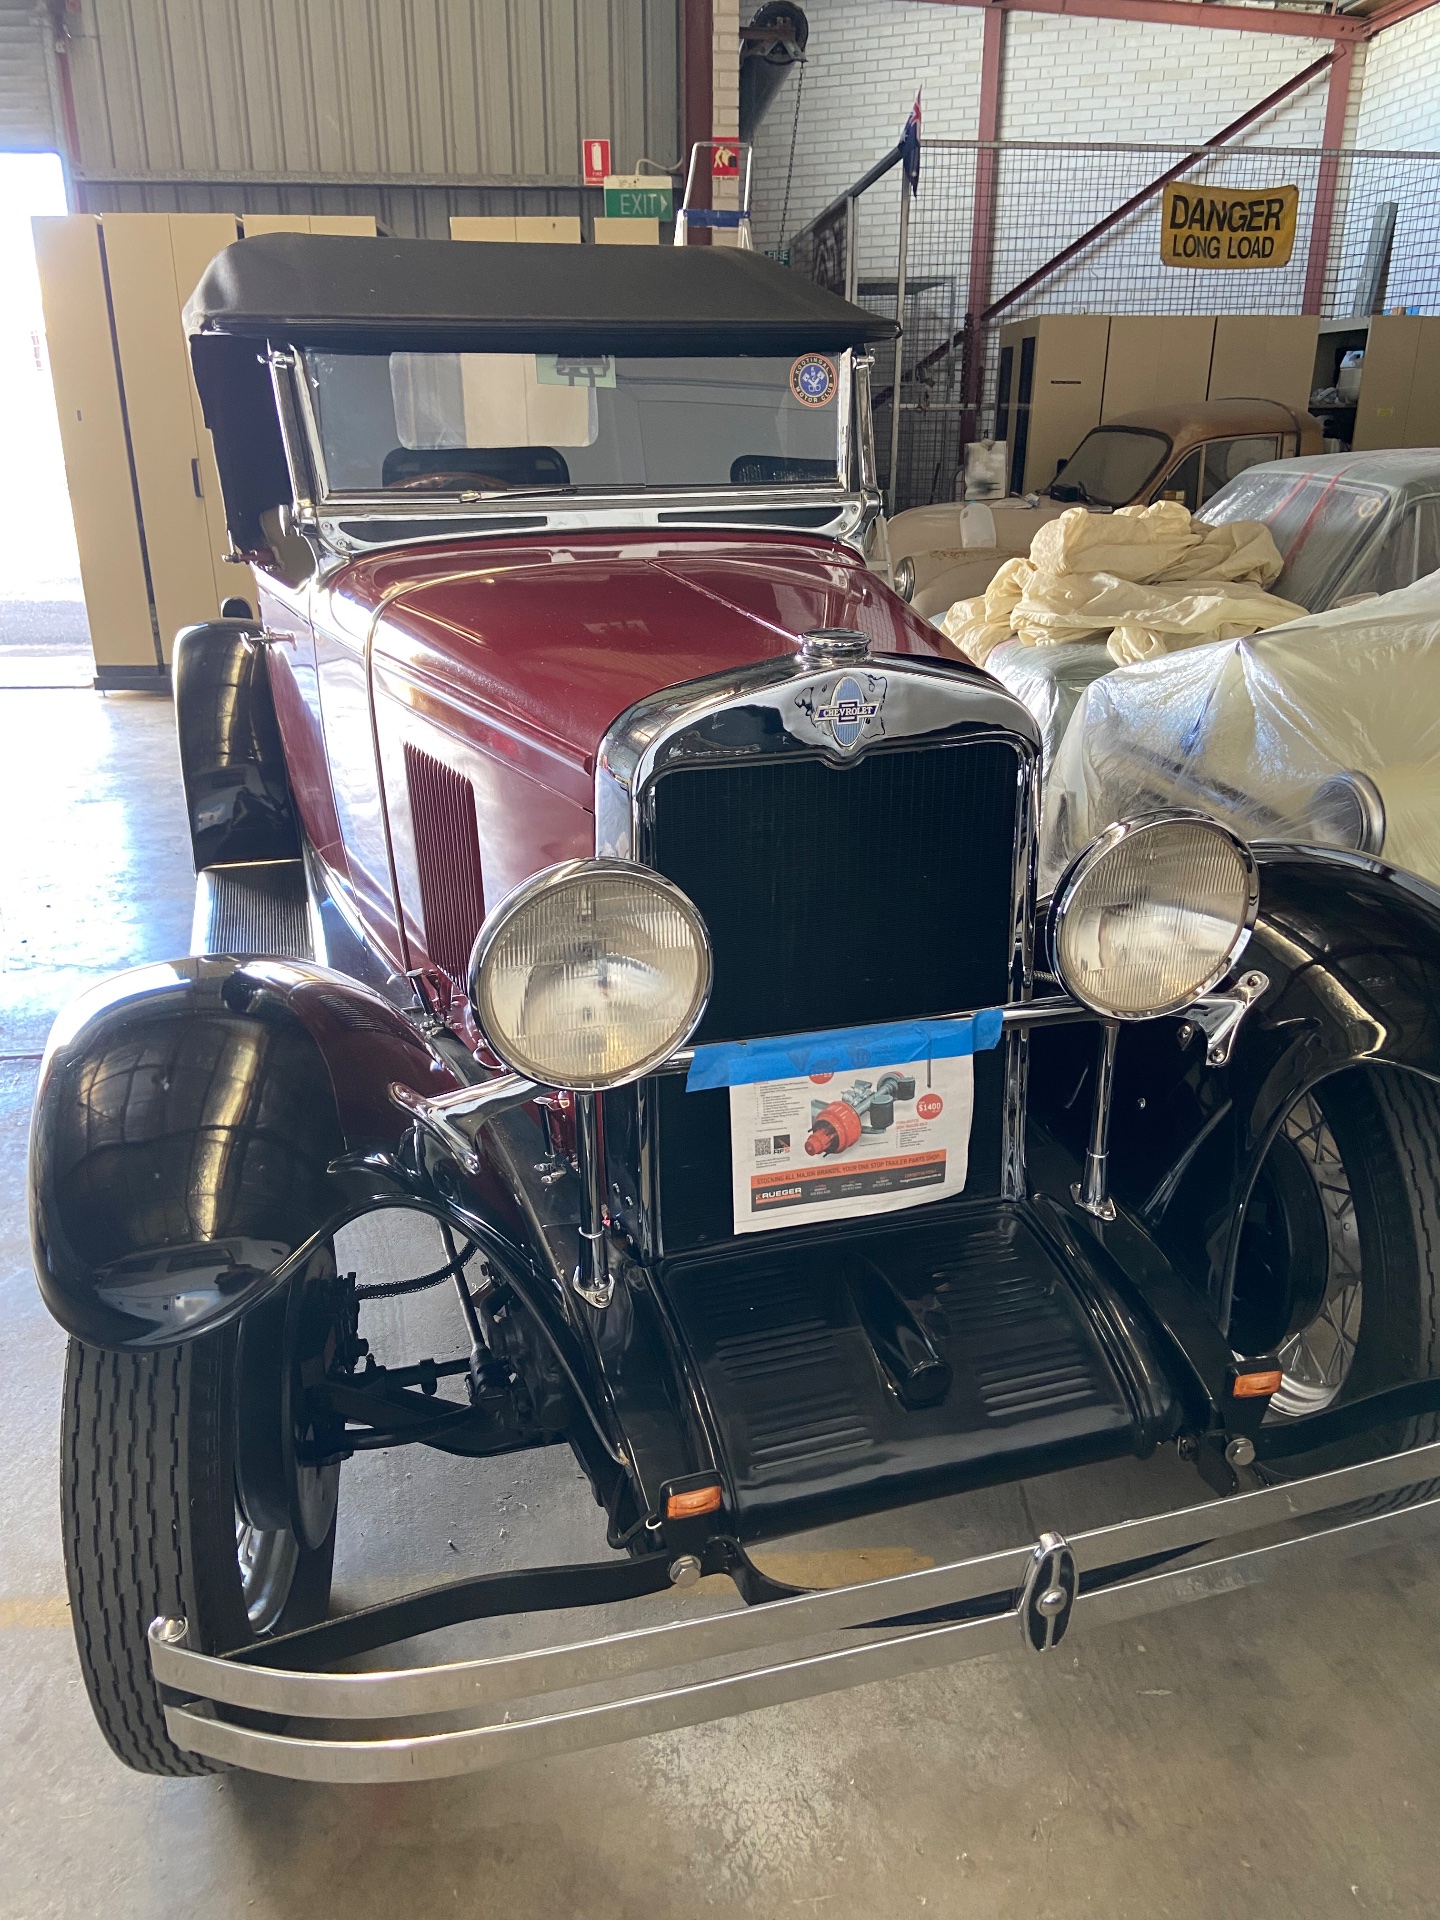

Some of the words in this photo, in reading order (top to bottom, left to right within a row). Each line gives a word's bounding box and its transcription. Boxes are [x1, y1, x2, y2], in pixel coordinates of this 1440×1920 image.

[620, 193, 657, 215] EXIT
[1170, 194, 1284, 232] DANGER
[1172, 234, 1220, 259] LONG
[1227, 236, 1274, 259] LOAD
[795, 357, 830, 374] KOOTINGAL
[795, 386, 818, 402] MOTOR
[821, 384, 833, 401] CLUB
[823, 706, 873, 717] CHEVROLET
[918, 1102, 941, 1112] $1400
[756, 1175, 784, 1185] STOCKING
[796, 1171, 816, 1179] MAJOR
[816, 1167, 842, 1177] BRANDS,
[858, 1163, 869, 1171] ONE
[870, 1161, 884, 1169] STOP
[885, 1158, 908, 1167] TRAILER
[908, 1156, 926, 1164] PARTS
[926, 1153, 940, 1161] SHOP
[755, 1187, 802, 1200] KRUEGER
